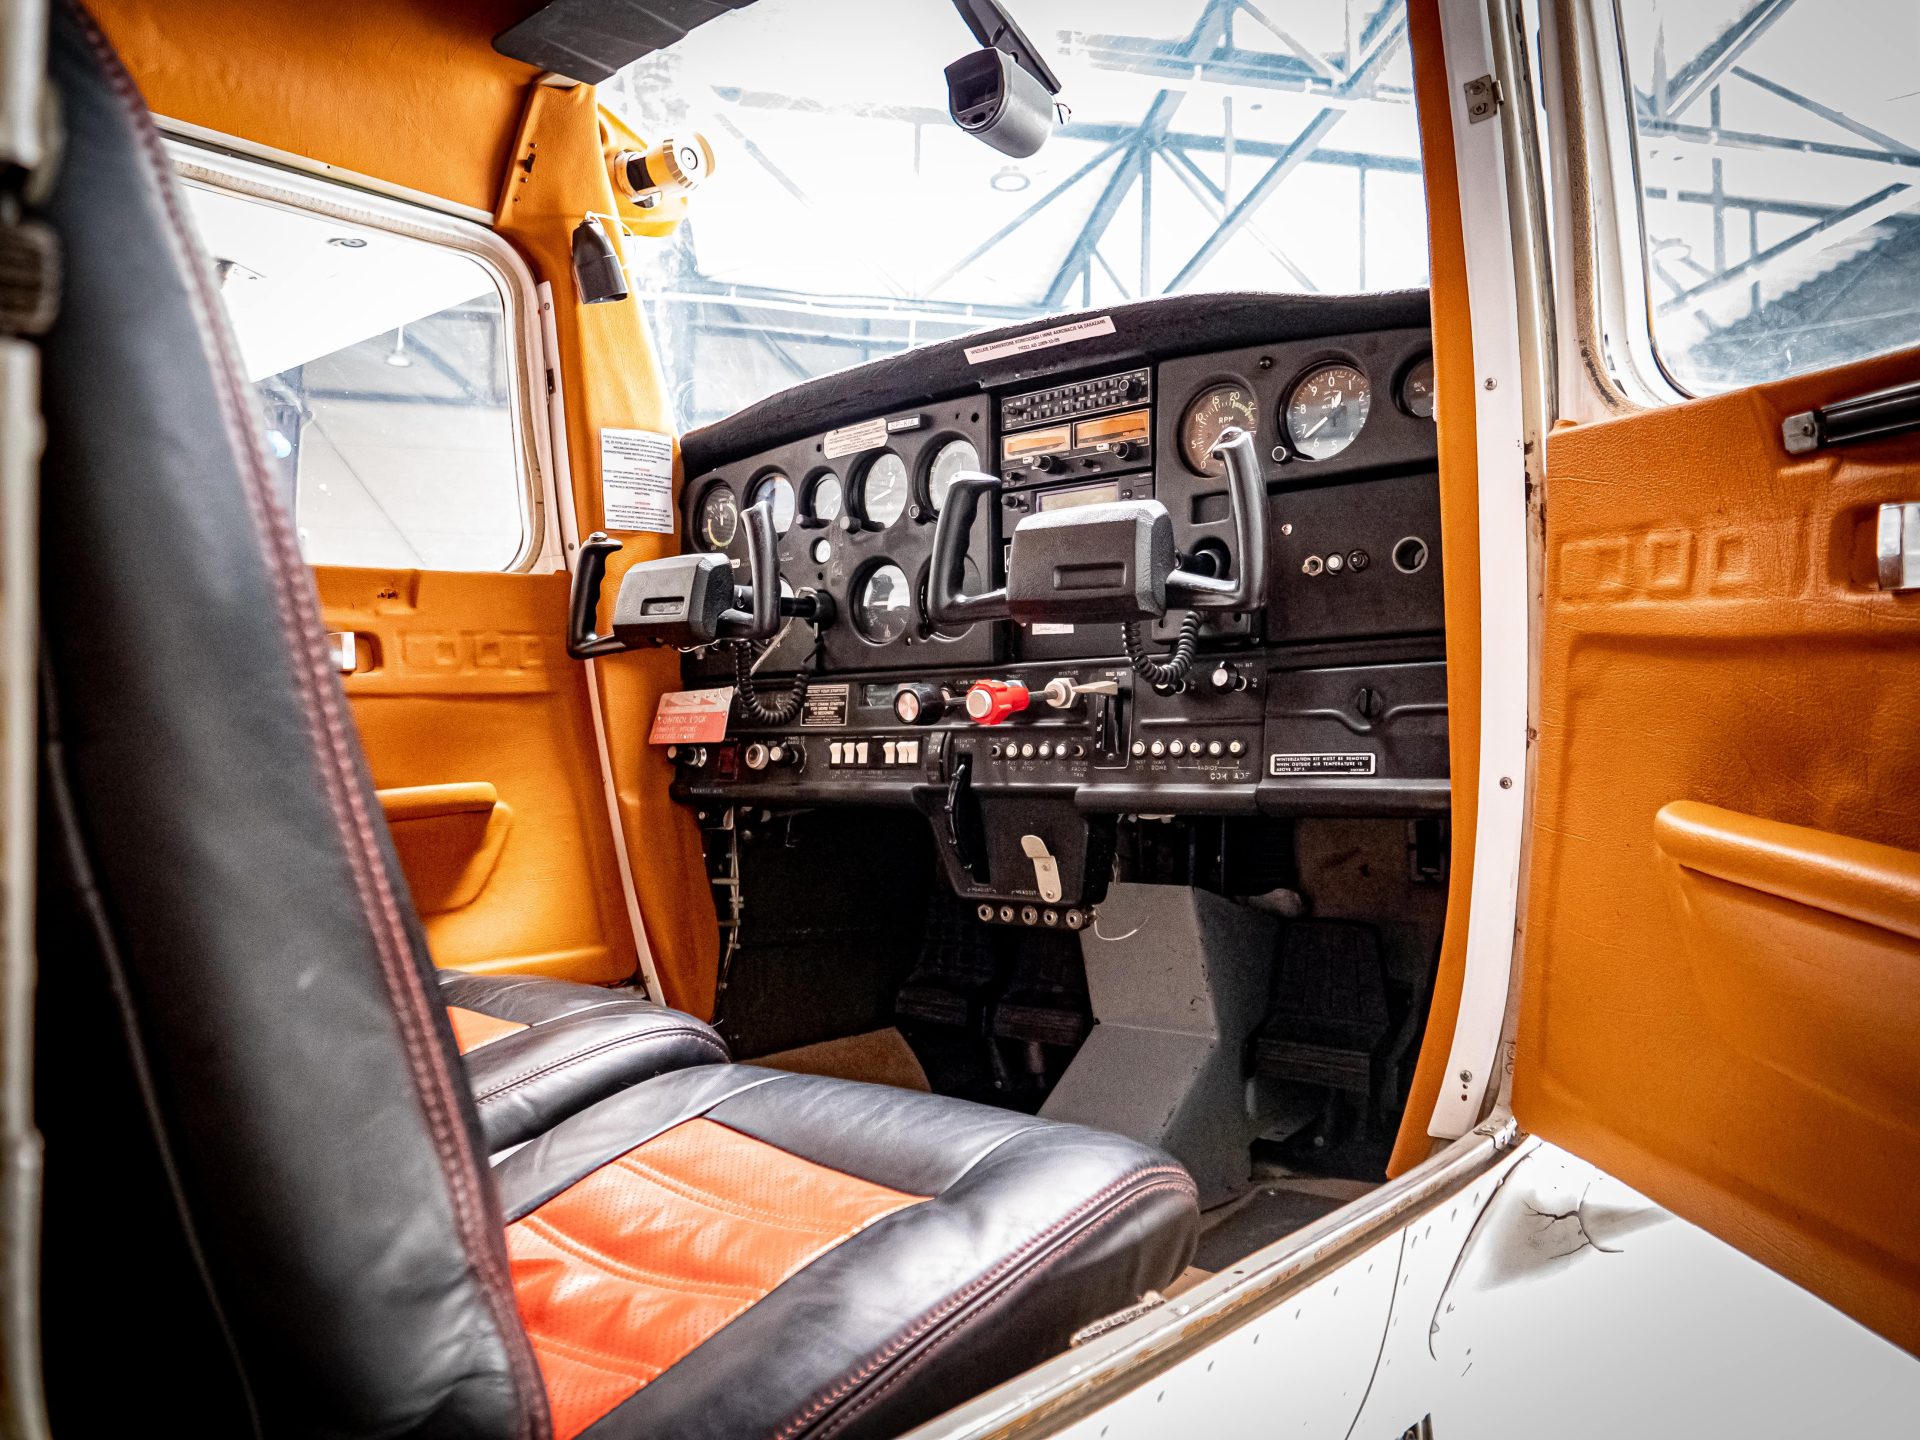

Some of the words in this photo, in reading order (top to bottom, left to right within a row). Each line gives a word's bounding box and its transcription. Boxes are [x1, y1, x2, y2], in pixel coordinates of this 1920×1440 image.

[1328, 376, 1335, 387] 0
[1311, 386, 1318, 396] 9
[1212, 396, 1220, 405] 15
[1230, 392, 1240, 400] 20
[1358, 391, 1365, 402] 2
[1300, 404, 1306, 414] 8
[1196, 413, 1204, 422] 10
[1219, 416, 1234, 424] RPM
[1301, 424, 1307, 434] 7
[1192, 440, 1197, 449] 5
[1314, 438, 1320, 448] 6
[1331, 440, 1338, 450] 5
[1200, 461, 1206, 470] 0
[689, 715, 708, 724] LOCK
[1233, 772, 1251, 780] ADF
